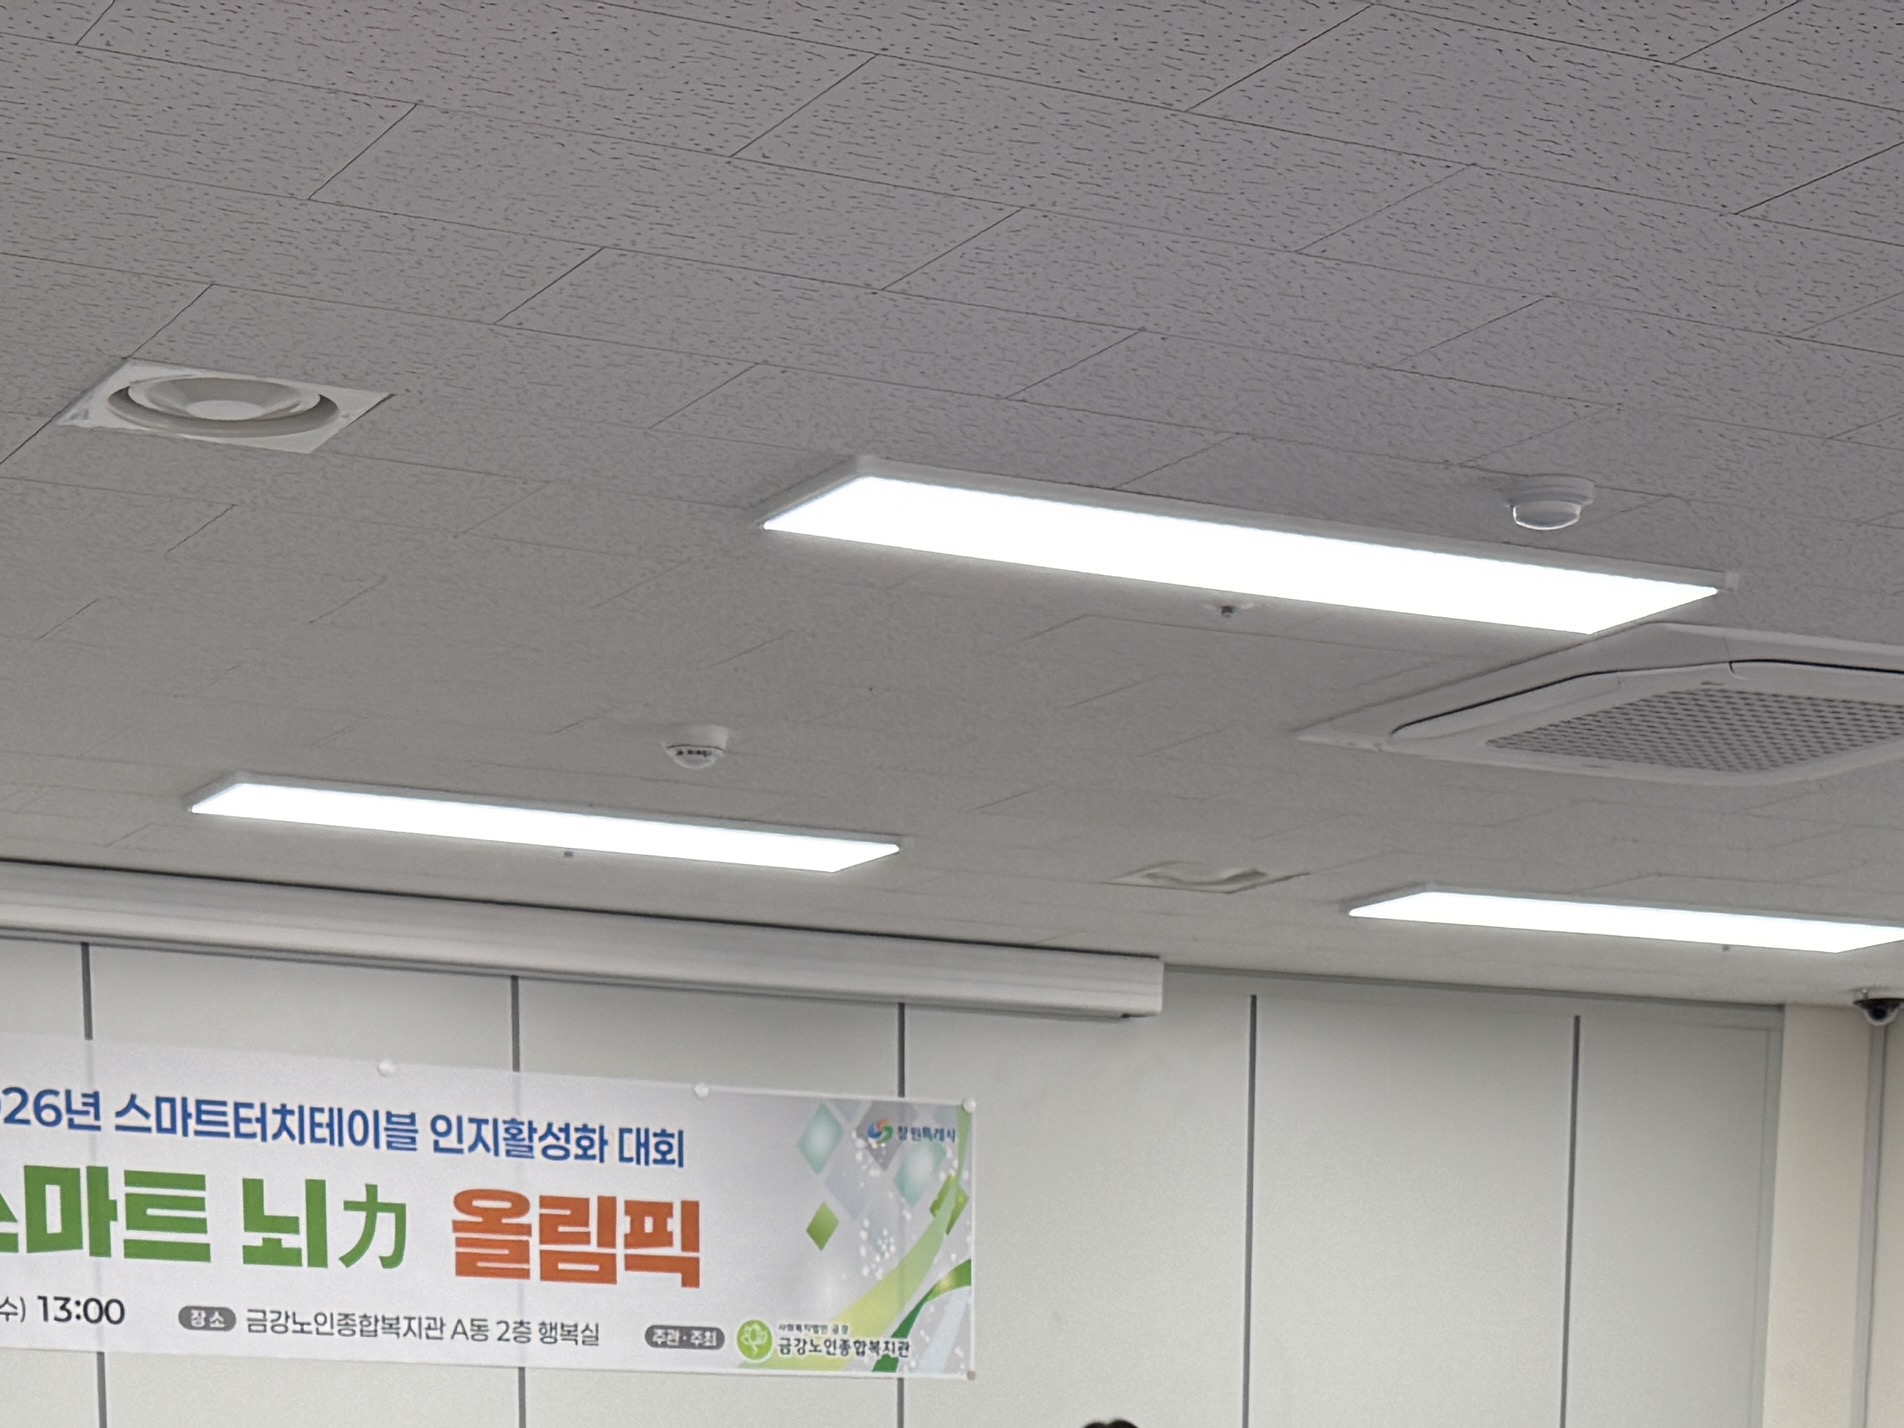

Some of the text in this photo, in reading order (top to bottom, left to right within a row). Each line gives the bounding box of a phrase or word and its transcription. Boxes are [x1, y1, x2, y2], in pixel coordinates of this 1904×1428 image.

[115, 1092, 420, 1152] 스마트터치테이블
[430, 1114, 608, 1166] 인지활성화
[618, 1127, 686, 1169] 대회
[452, 1187, 701, 1289] 올림픽
[38, 1296, 126, 1326] 13:00
[189, 1308, 601, 1348] 장소 금강노인종합복지관 A동 2층 행복실
[778, 1336, 910, 1358] 금강노인종합복지관
